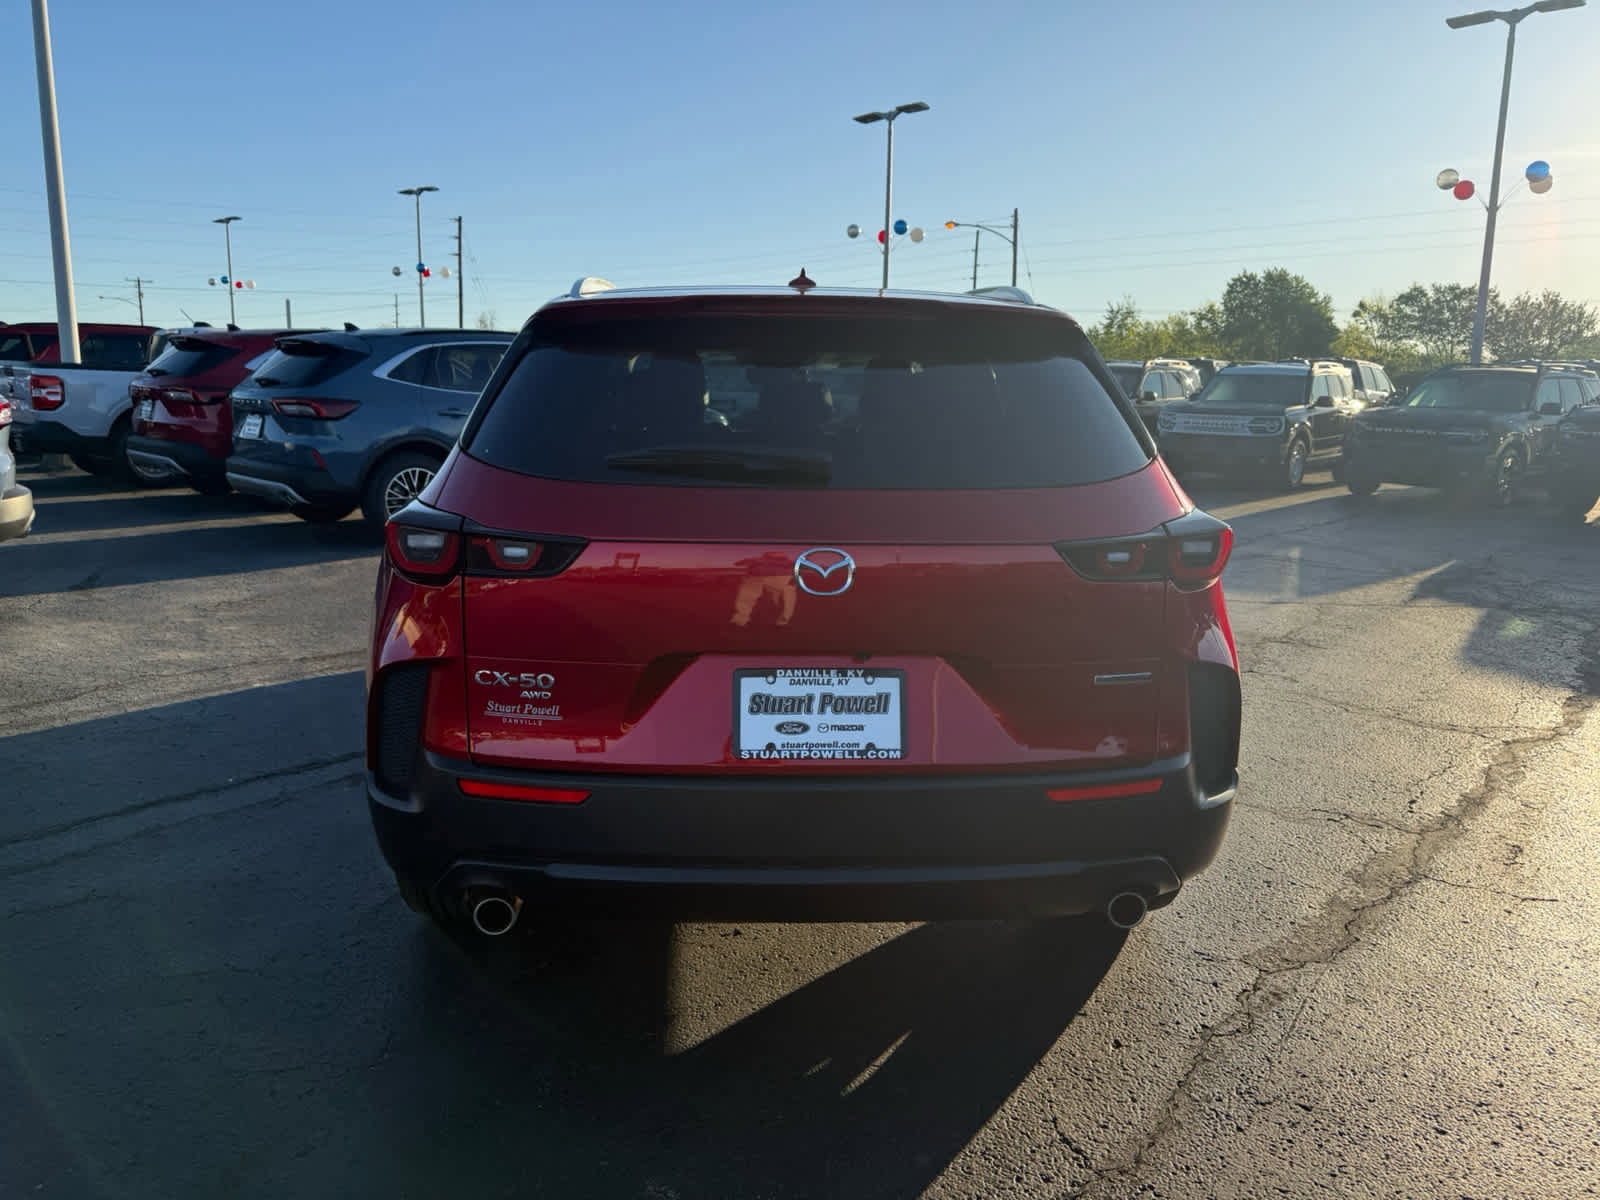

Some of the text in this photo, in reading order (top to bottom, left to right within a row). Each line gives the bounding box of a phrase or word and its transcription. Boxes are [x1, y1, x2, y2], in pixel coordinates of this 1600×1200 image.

[847, 669, 864, 677] KY
[474, 669, 555, 689] CX-50
[789, 679, 835, 687] DANVILLE,
[520, 690, 552, 699] AWD
[487, 700, 560, 716] Stuart Powell
[748, 692, 891, 715] Stuart Powell
[830, 724, 865, 732] mazda
[780, 742, 860, 750] stuartpowell.com
[740, 750, 901, 759] STUARTPOWELL.COM
